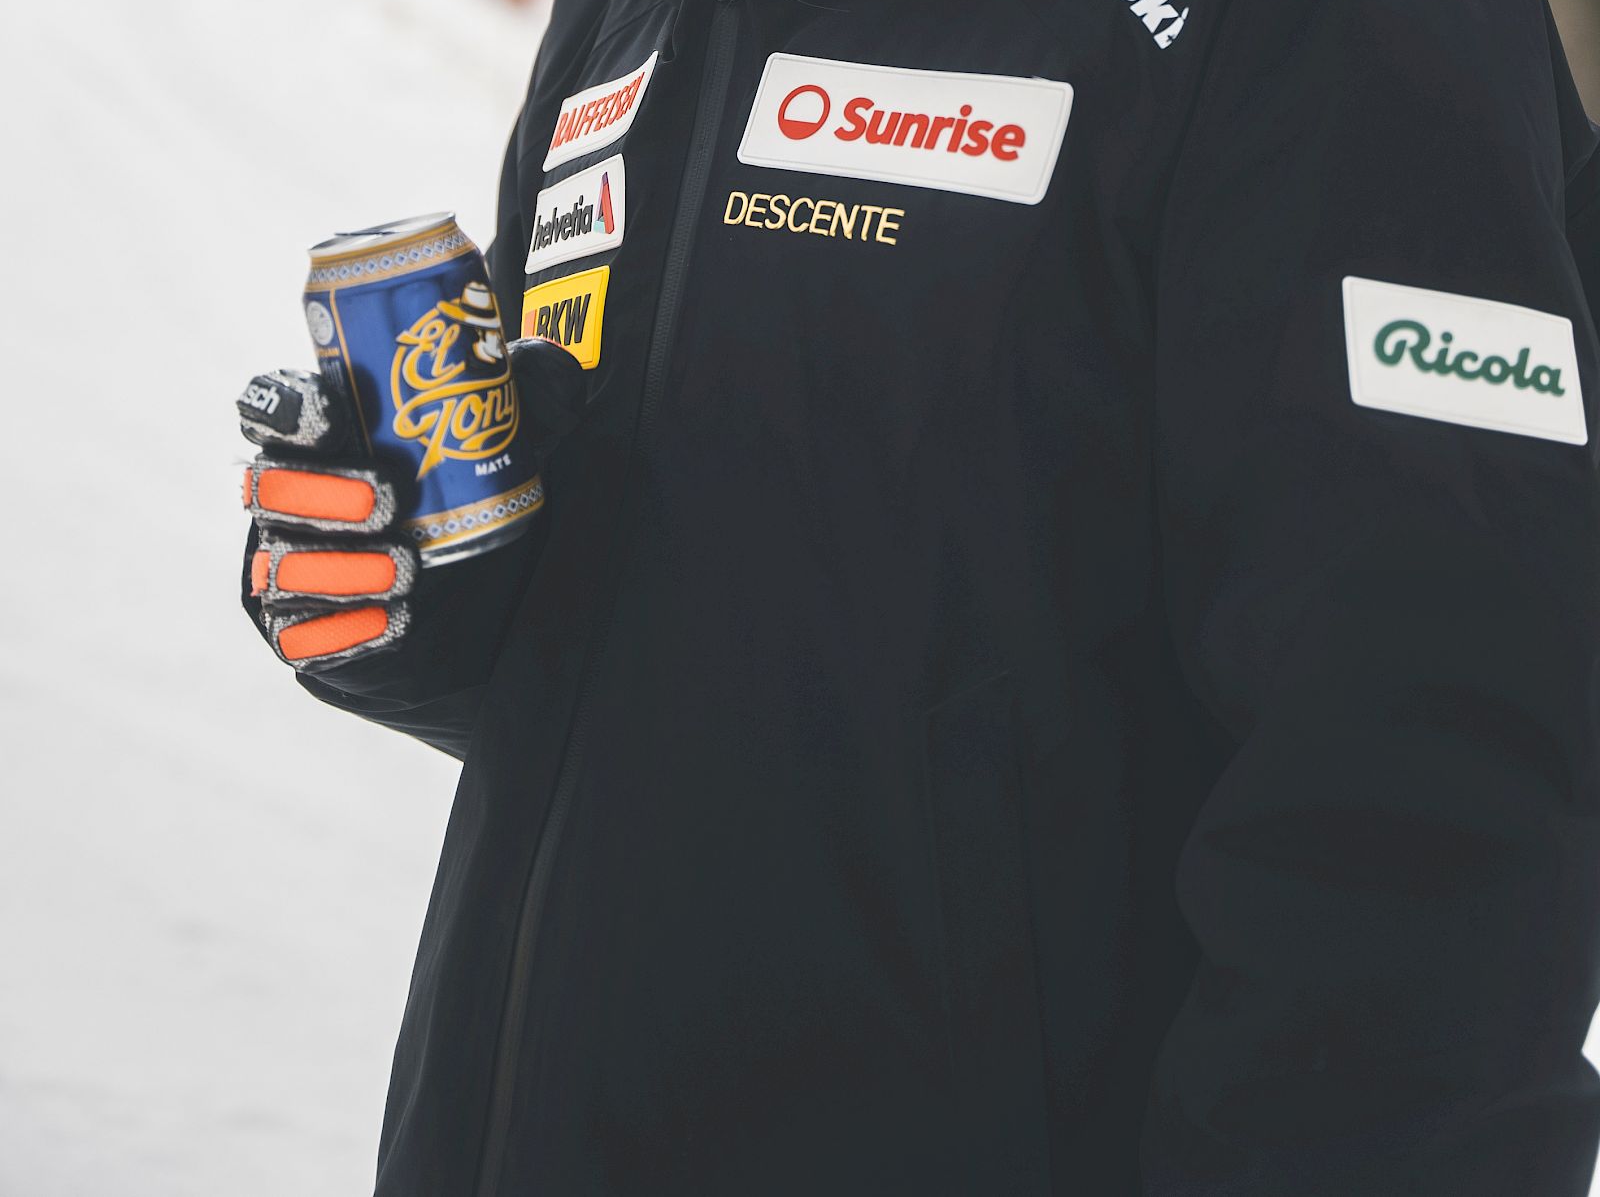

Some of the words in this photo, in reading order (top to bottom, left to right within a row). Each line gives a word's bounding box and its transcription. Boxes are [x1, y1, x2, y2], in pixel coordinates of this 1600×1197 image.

[550, 71, 645, 151] RAIFFEISEN
[833, 97, 1026, 162] Sunrise
[532, 195, 594, 252] helvetia
[723, 191, 905, 246] DESCENTE
[536, 292, 591, 346] BKW
[396, 319, 465, 391] El
[1373, 319, 1566, 397] Ricola
[240, 383, 281, 415] sch
[393, 370, 513, 482] Tony
